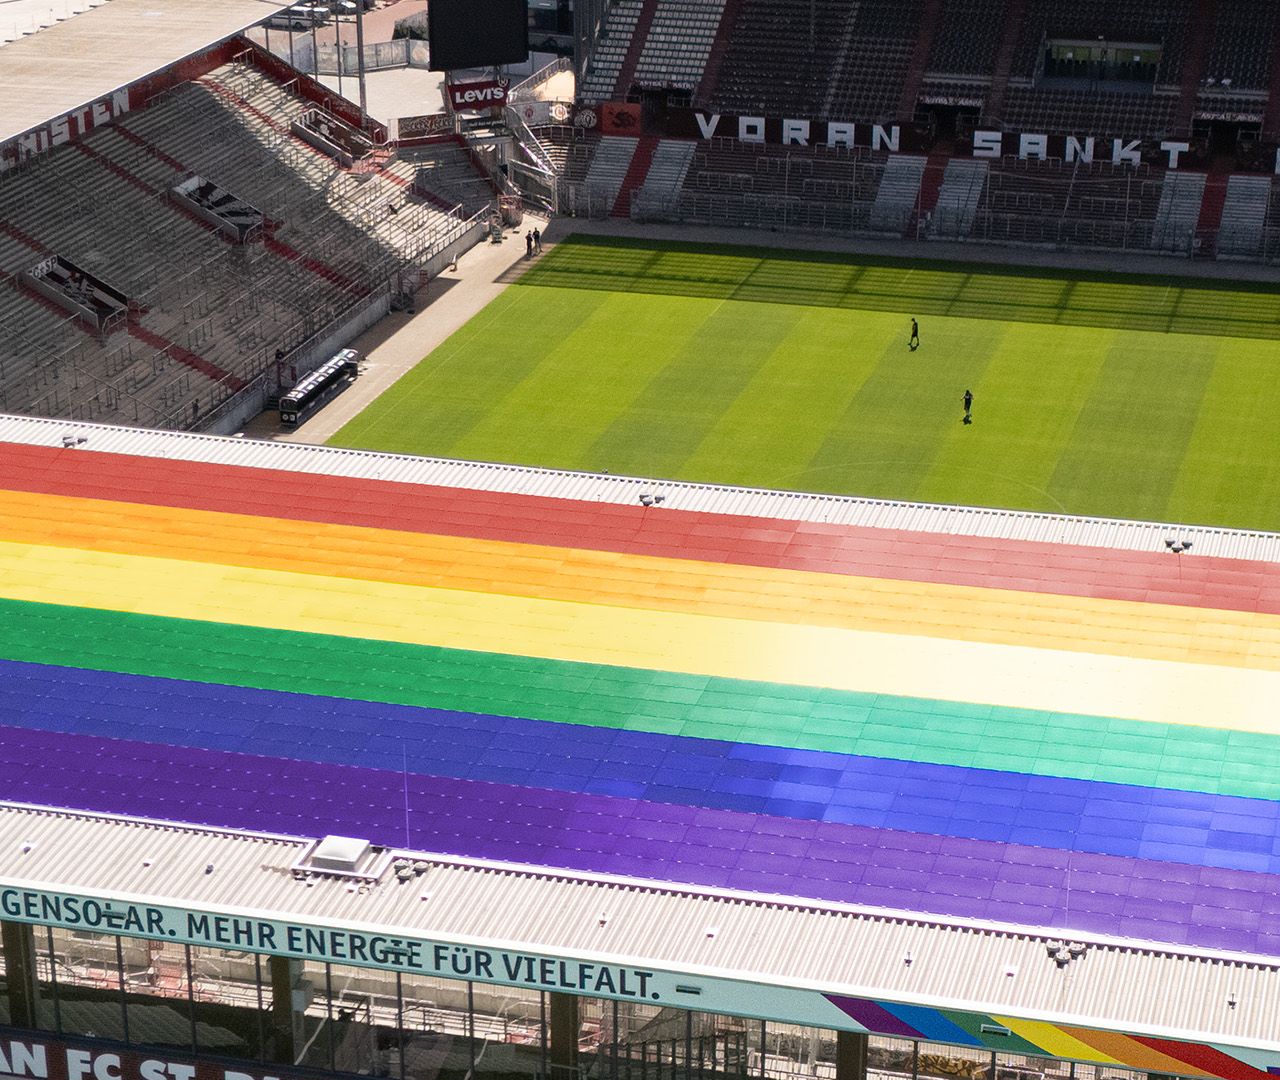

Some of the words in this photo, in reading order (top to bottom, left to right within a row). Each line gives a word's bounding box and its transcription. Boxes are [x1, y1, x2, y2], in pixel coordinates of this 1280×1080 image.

[695, 112, 901, 152] VORAN
[972, 130, 1190, 169] SANKT
[187, 912, 278, 951] MEHR
[287, 926, 423, 969] ENERGIE
[434, 945, 494, 978] FÜR
[503, 954, 660, 1000] VIELFALT.
